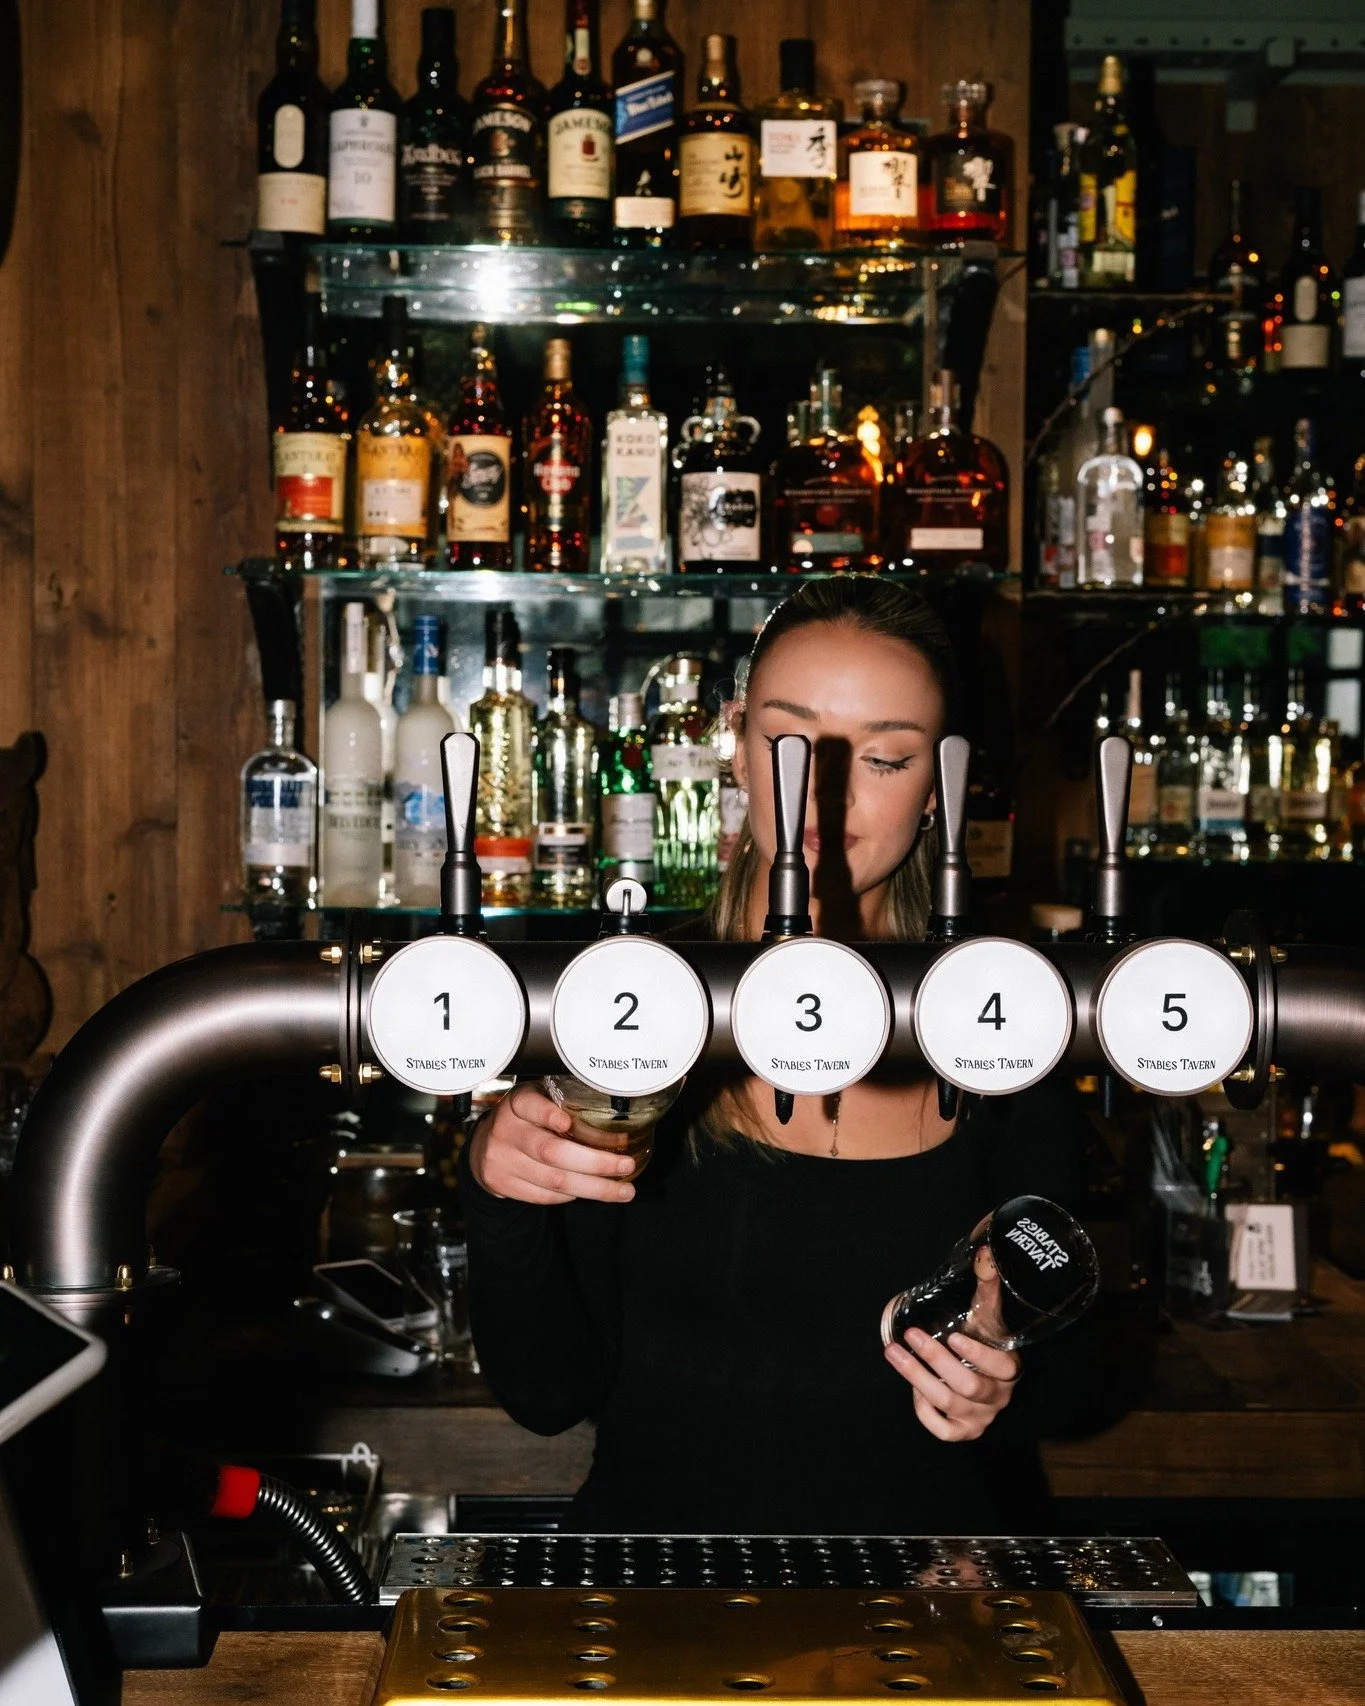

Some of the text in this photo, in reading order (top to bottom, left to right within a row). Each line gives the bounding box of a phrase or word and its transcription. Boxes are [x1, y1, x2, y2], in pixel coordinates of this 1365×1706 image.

[434, 992, 450, 1031] 1
[613, 992, 639, 1030] 2
[796, 993, 822, 1032] 3
[977, 992, 1006, 1031] 4
[1161, 993, 1188, 1031] 5
[449, 1057, 486, 1069] TAVERN
[632, 1058, 669, 1069] TAVERN
[814, 1059, 850, 1070] TAVERN
[998, 1057, 1034, 1069] TAVERN
[1180, 1058, 1216, 1069] TAVERN
